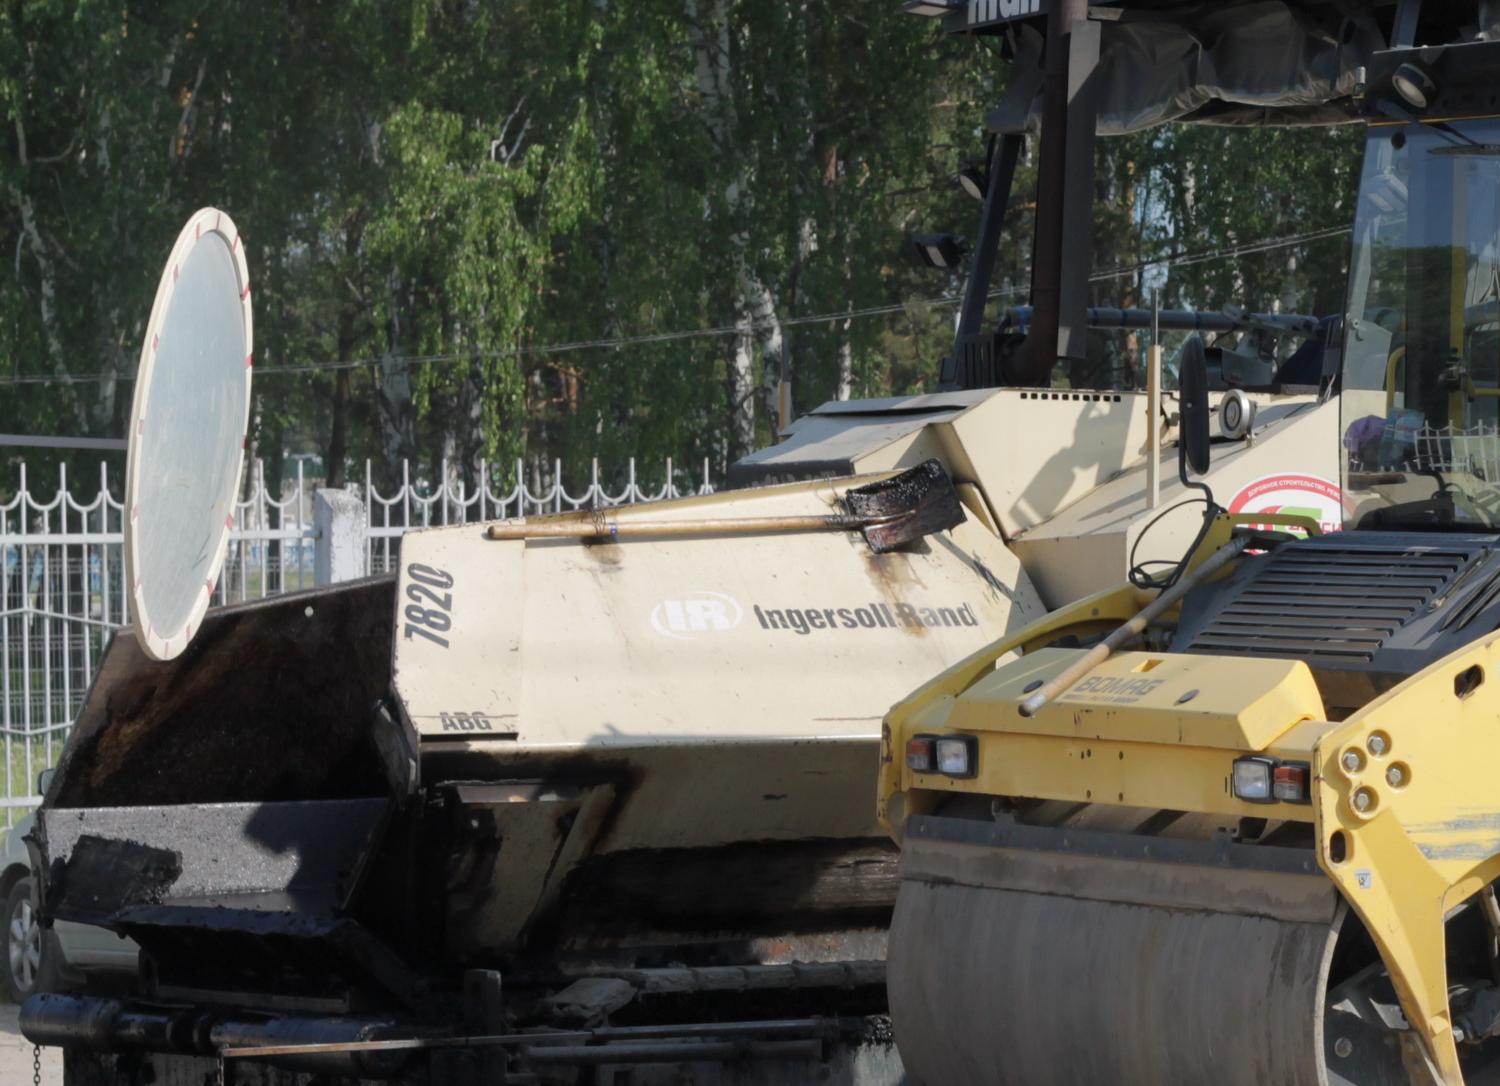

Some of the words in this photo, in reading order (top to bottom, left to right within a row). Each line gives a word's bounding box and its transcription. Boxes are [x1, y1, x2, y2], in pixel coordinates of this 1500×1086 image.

[404, 562, 454, 649] 7820
[753, 603, 897, 635] Ingersoll
[894, 602, 978, 627] Rand
[1074, 676, 1167, 695] BOMAG
[439, 711, 492, 731] ABG
